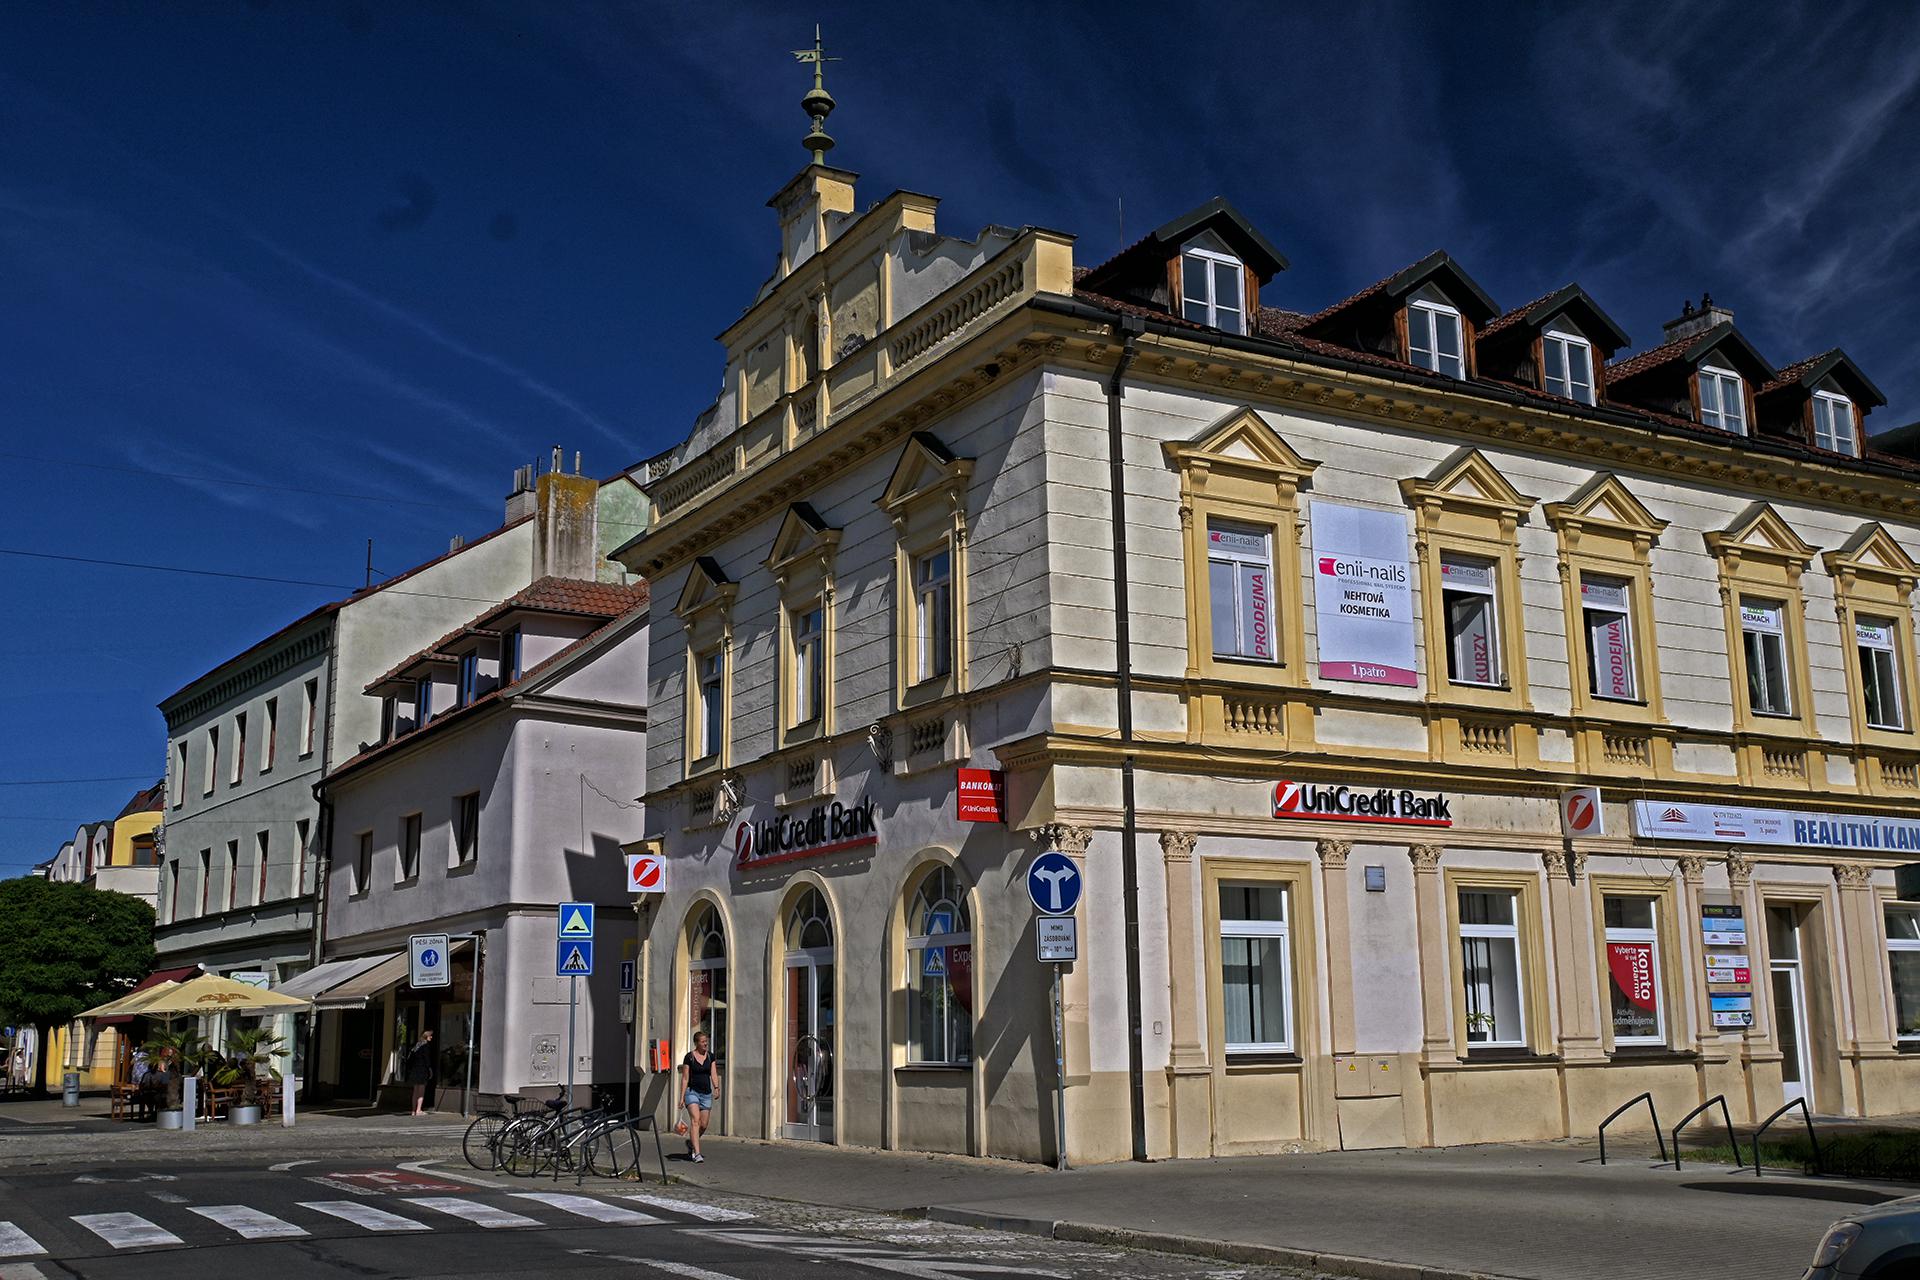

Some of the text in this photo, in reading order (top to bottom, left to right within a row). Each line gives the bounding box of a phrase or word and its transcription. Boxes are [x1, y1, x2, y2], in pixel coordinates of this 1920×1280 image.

[1221, 533, 1260, 547] enii-nails
[1336, 560, 1406, 582] enii-nails
[1340, 603, 1390, 618] KOSMETIKA
[1344, 590, 1384, 604] NEHTOVÁ
[1252, 574, 1267, 656] PRODEJNA
[1742, 613, 1770, 624] REMACH
[1856, 631, 1881, 640] REMACH
[1473, 633, 1488, 682] KURZY
[1608, 622, 1624, 696] PRODEJNA
[1302, 783, 1452, 819] UniCredit Bank
[754, 795, 876, 857] UniCredit Bank
[1794, 819, 1879, 849] REALITNÍ
[1632, 961, 1640, 999] zdarma
[1637, 948, 1651, 1000] konto
